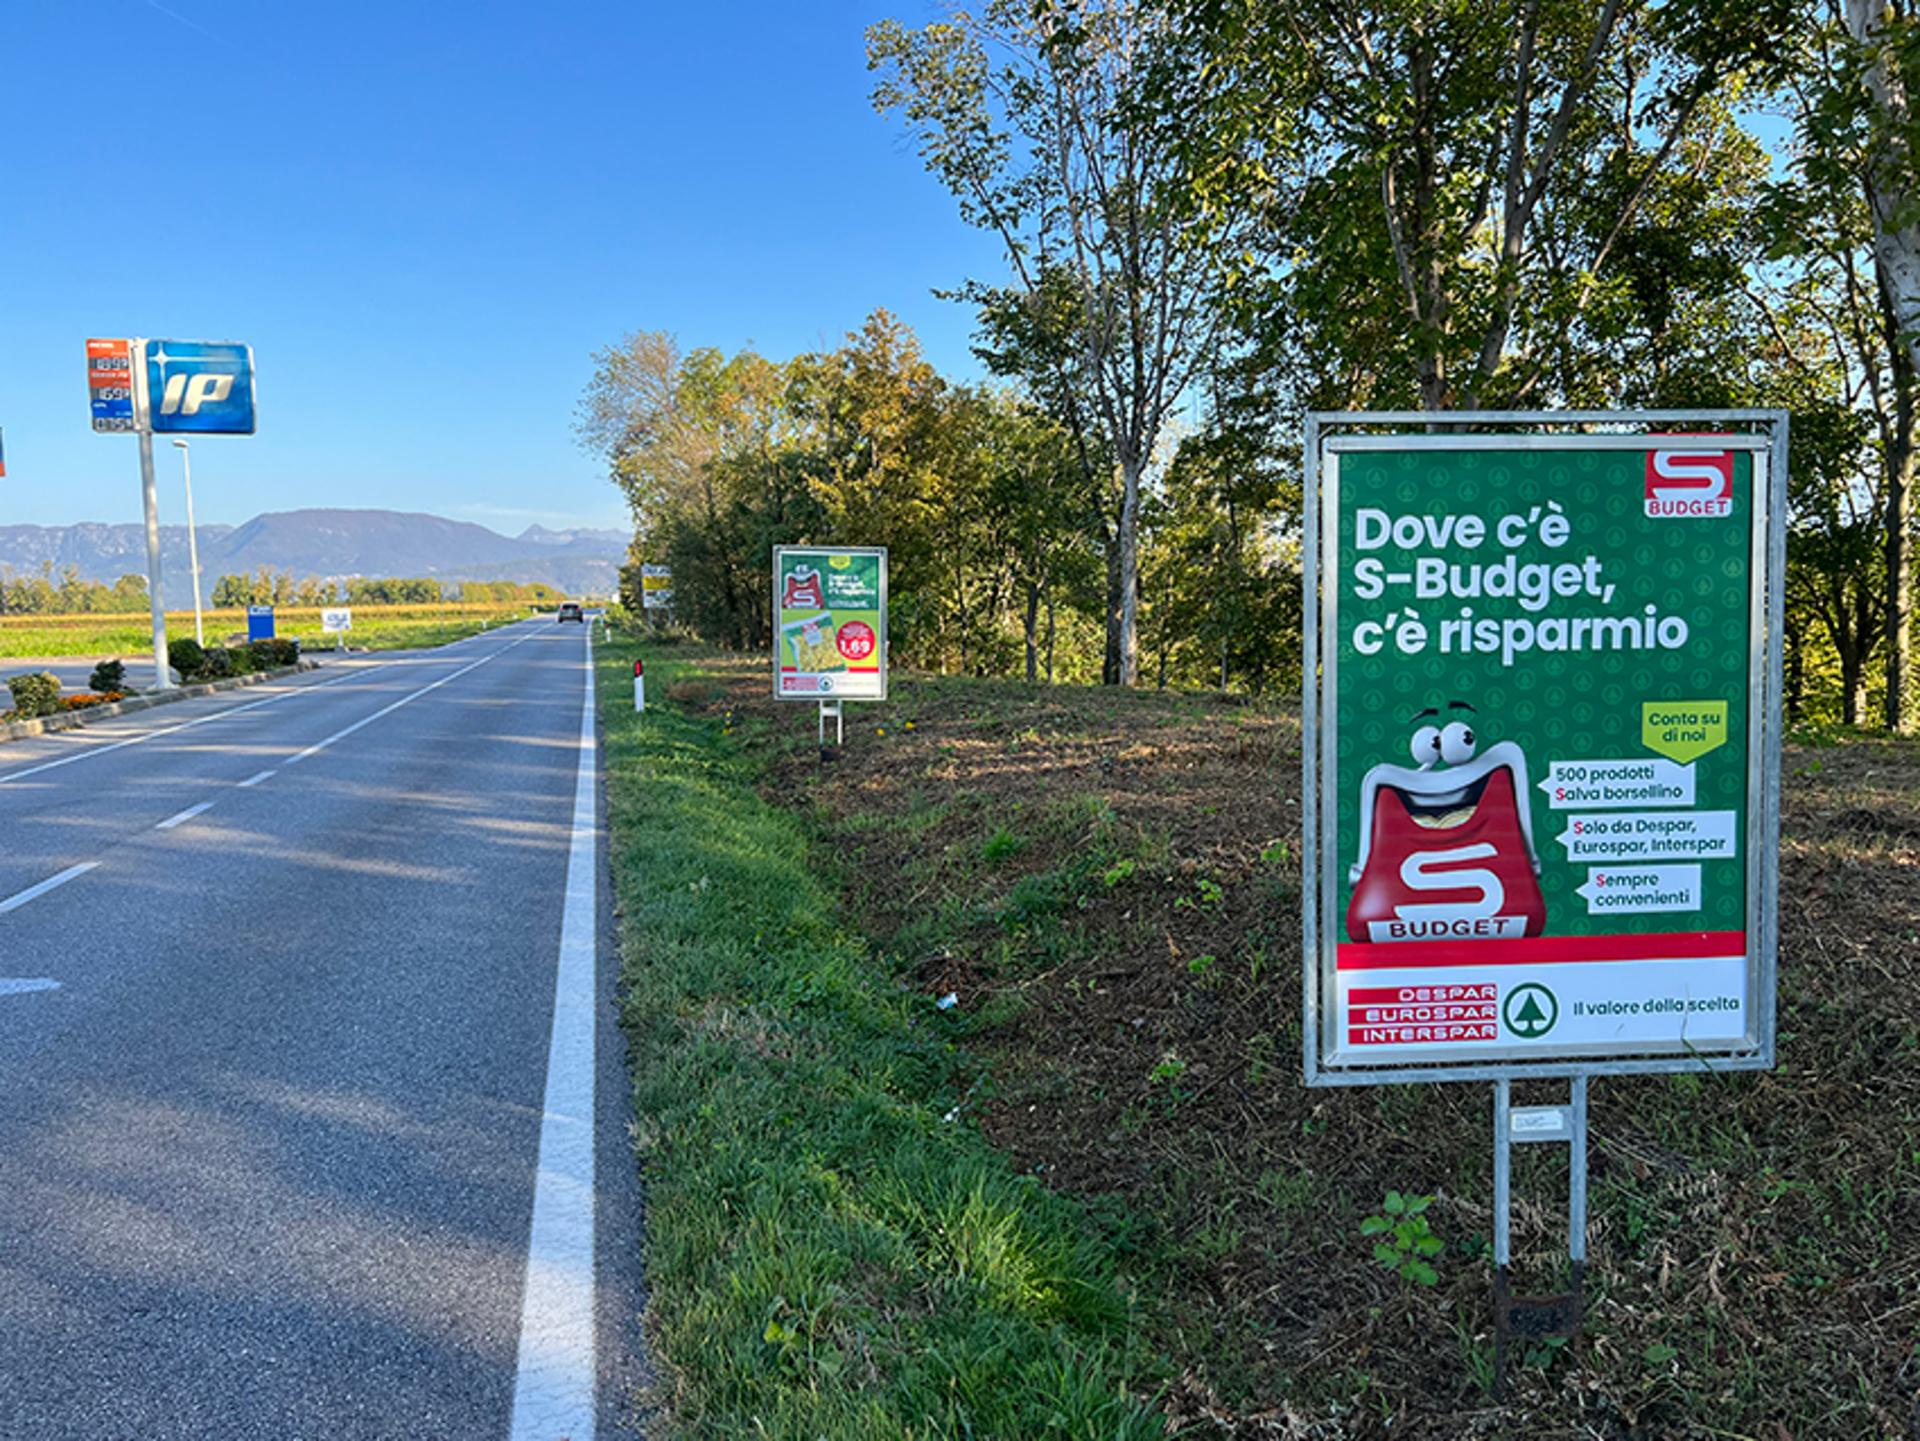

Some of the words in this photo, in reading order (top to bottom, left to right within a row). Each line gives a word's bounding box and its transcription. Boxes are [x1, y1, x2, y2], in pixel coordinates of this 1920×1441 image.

[160, 373, 235, 415] IP
[1648, 500, 1728, 515] BUDGET
[1356, 508, 1485, 549] Dove
[1497, 500, 1570, 547] c'è
[1354, 555, 1616, 611] S-Budget,
[1353, 606, 1428, 655] c'è
[1440, 603, 1688, 666] risparmio
[1649, 713, 1698, 726] Conta
[1702, 712, 1721, 725] su
[1662, 728, 1679, 742] di
[1683, 727, 1706, 741] noi
[1556, 767, 1587, 781] 500
[1590, 765, 1655, 784] prodotti
[1555, 787, 1600, 801] Salva
[1603, 783, 1683, 799] borsellino
[1573, 821, 1608, 835] Solo
[1611, 820, 1632, 834] da
[1636, 818, 1697, 837] Despar,
[1573, 840, 1649, 856] Eurospar,
[1651, 836, 1726, 853] Interspar
[1596, 873, 1659, 889] Sempre
[1596, 889, 1690, 906] convenienti
[1389, 919, 1510, 938] BUDGET
[1398, 985, 1497, 1001] DESPAR
[1365, 1005, 1497, 1022] EUROSPAR
[1573, 1001, 1584, 1016] Il
[1586, 999, 1640, 1016] valore
[1642, 997, 1684, 1013] della
[1687, 996, 1740, 1012] scelta
[1363, 1026, 1497, 1042] INTERSPAR
